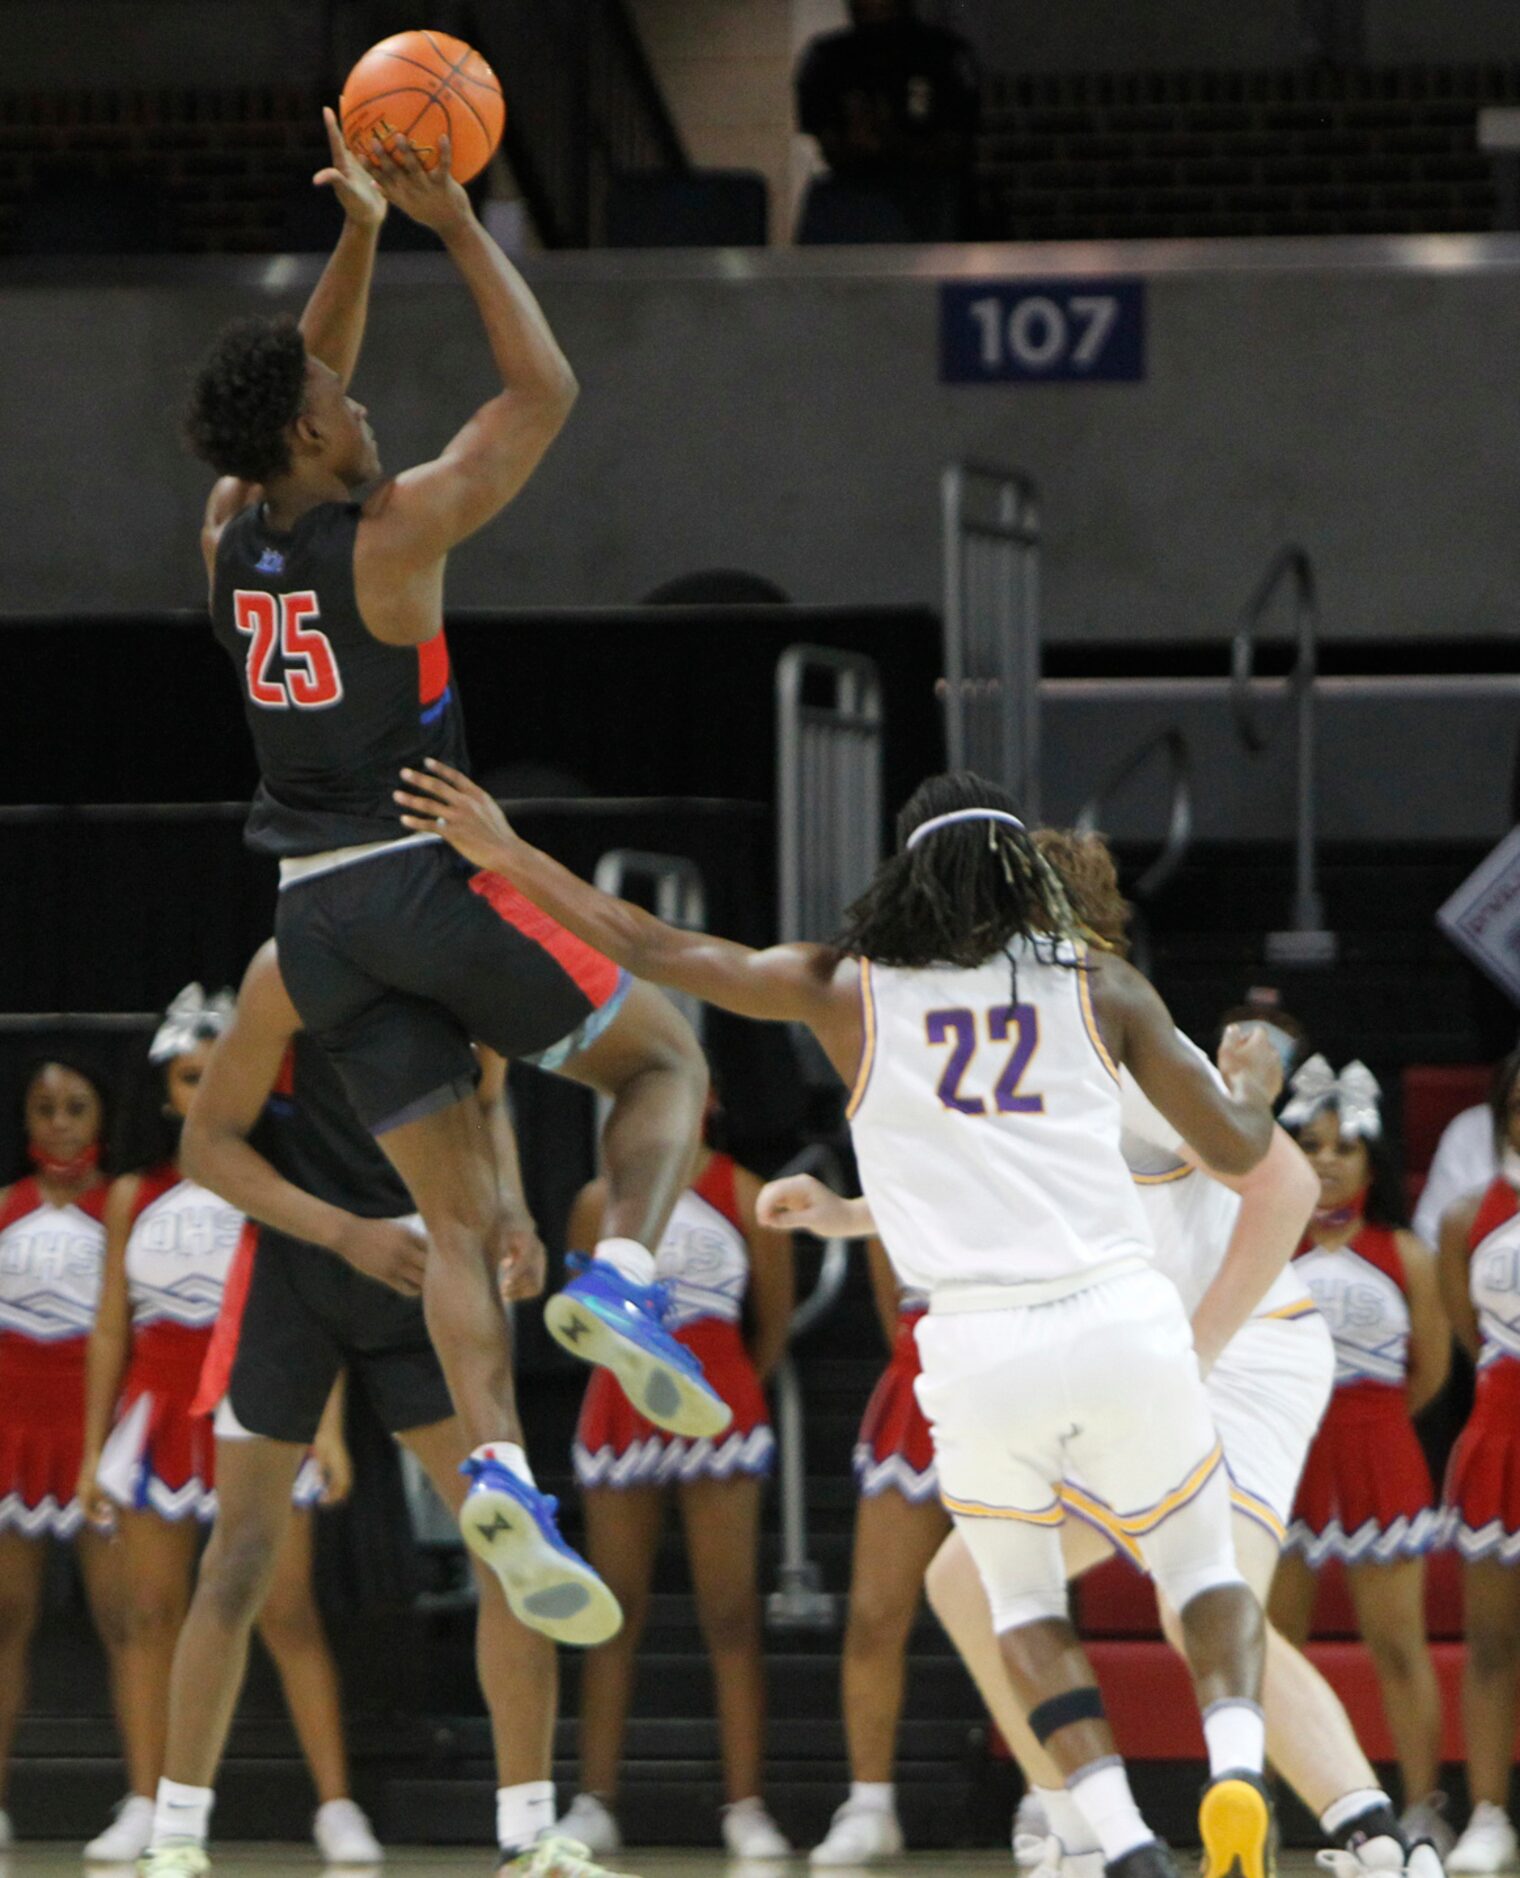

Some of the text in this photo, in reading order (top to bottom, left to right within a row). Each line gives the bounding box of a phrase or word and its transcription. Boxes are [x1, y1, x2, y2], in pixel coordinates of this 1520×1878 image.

[970, 296, 1117, 364] 107
[233, 588, 344, 708] 25
[924, 1002, 1046, 1117] 22
[656, 1222, 724, 1277] HS
[1306, 1278, 1386, 1330] HS
